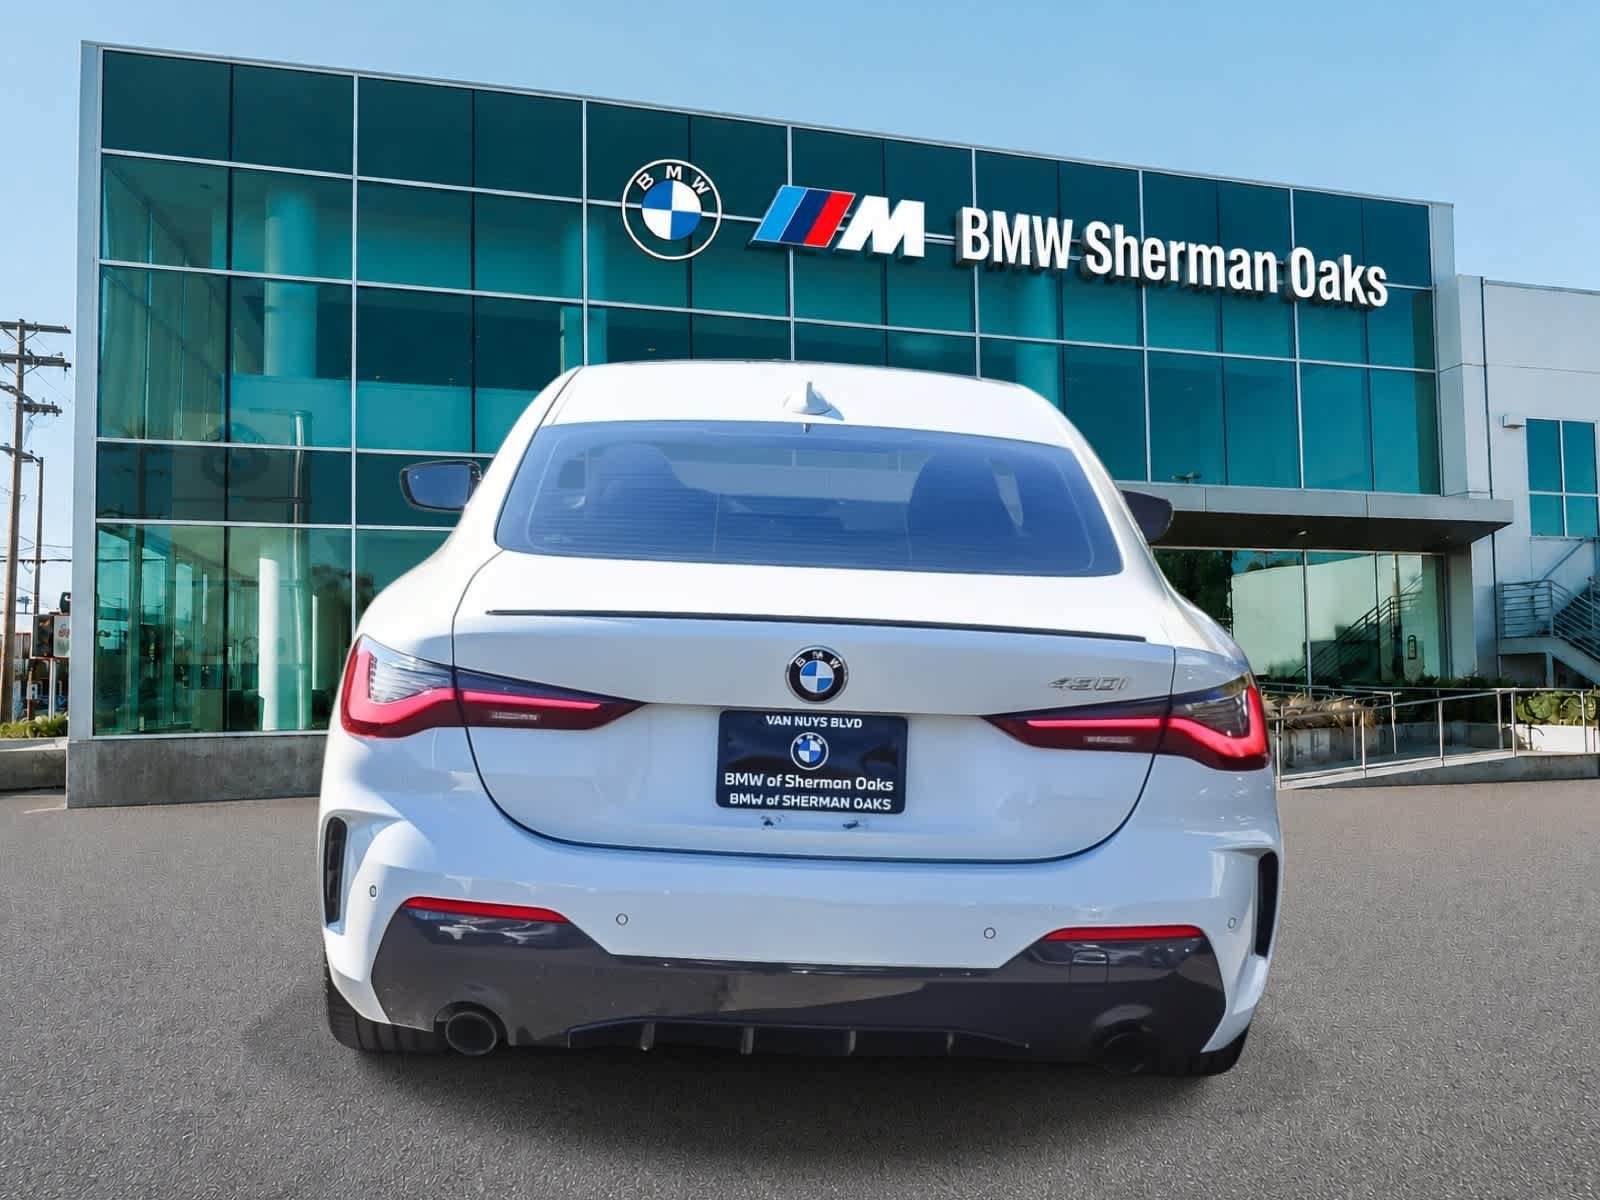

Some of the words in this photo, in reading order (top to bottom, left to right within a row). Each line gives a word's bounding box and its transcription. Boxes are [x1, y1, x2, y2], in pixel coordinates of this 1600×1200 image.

[637, 165, 711, 196] BMW
[958, 206, 1074, 270] BMW
[1084, 220, 1279, 294] Sherman
[1289, 247, 1389, 308] Oaks
[796, 651, 841, 670] BMW
[766, 715, 791, 726] VAN
[794, 716, 828, 727] NUYS
[830, 717, 863, 729] BLVD
[724, 773, 764, 786] BMW
[767, 774, 783, 787] of
[785, 774, 851, 790] Sherman
[855, 777, 894, 791] Oaks
[730, 793, 763, 805] BMW
[766, 794, 779, 806] of
[782, 795, 850, 809] SHERMAN
[854, 797, 892, 810] OAKS
